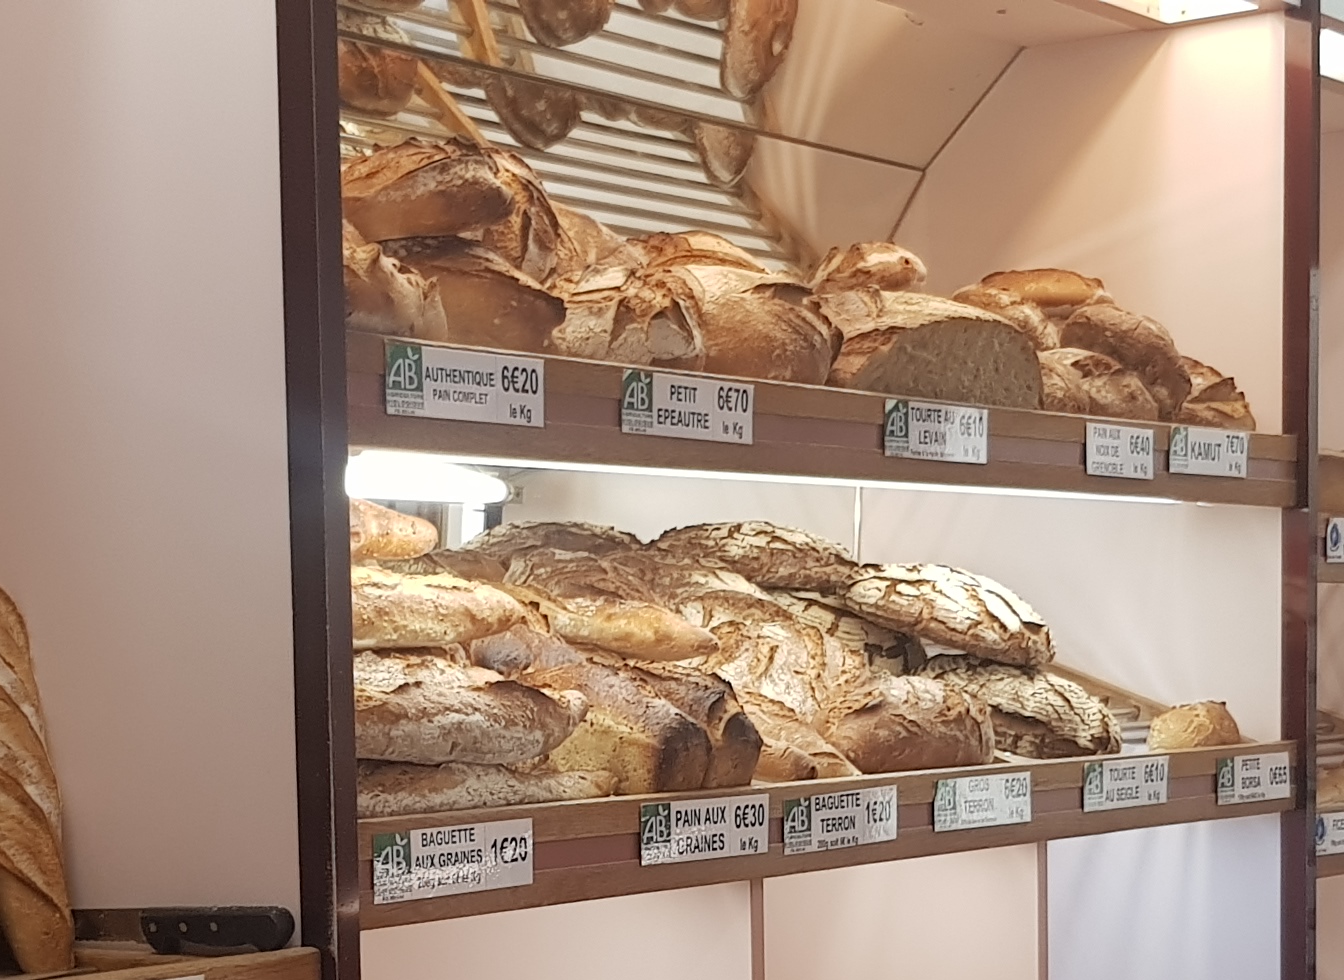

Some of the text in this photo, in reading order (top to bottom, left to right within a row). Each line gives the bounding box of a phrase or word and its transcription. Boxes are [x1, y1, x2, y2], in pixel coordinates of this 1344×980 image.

[425, 367, 496, 387] AUTHENTIQUE
[502, 366, 538, 395] 6€20
[433, 389, 488, 405] PAIN COMPLET
[670, 385, 698, 403] PETIT
[718, 386, 748, 413] 6€70
[510, 404, 531, 423] le Kg
[657, 408, 710, 429] EPEAUTRE
[911, 407, 942, 424] TOURTE
[722, 421, 743, 439] le Kg
[919, 430, 946, 446] LEVAIN
[1129, 435, 1150, 456] 6€40
[1190, 441, 1221, 462] KAMUT
[969, 778, 989, 792] GROS
[815, 792, 860, 811] BAGUETTE
[964, 798, 994, 813] TERRON
[676, 806, 726, 827] PAIN AUX
[735, 804, 764, 829] 6€30
[866, 801, 891, 824] 1€20
[820, 815, 855, 834] TERRON
[421, 827, 475, 847] BAGUETTE
[748, 837, 758, 852] Kg
[415, 849, 482, 869] AUX GRAINES
[491, 836, 528, 866] 1€20
